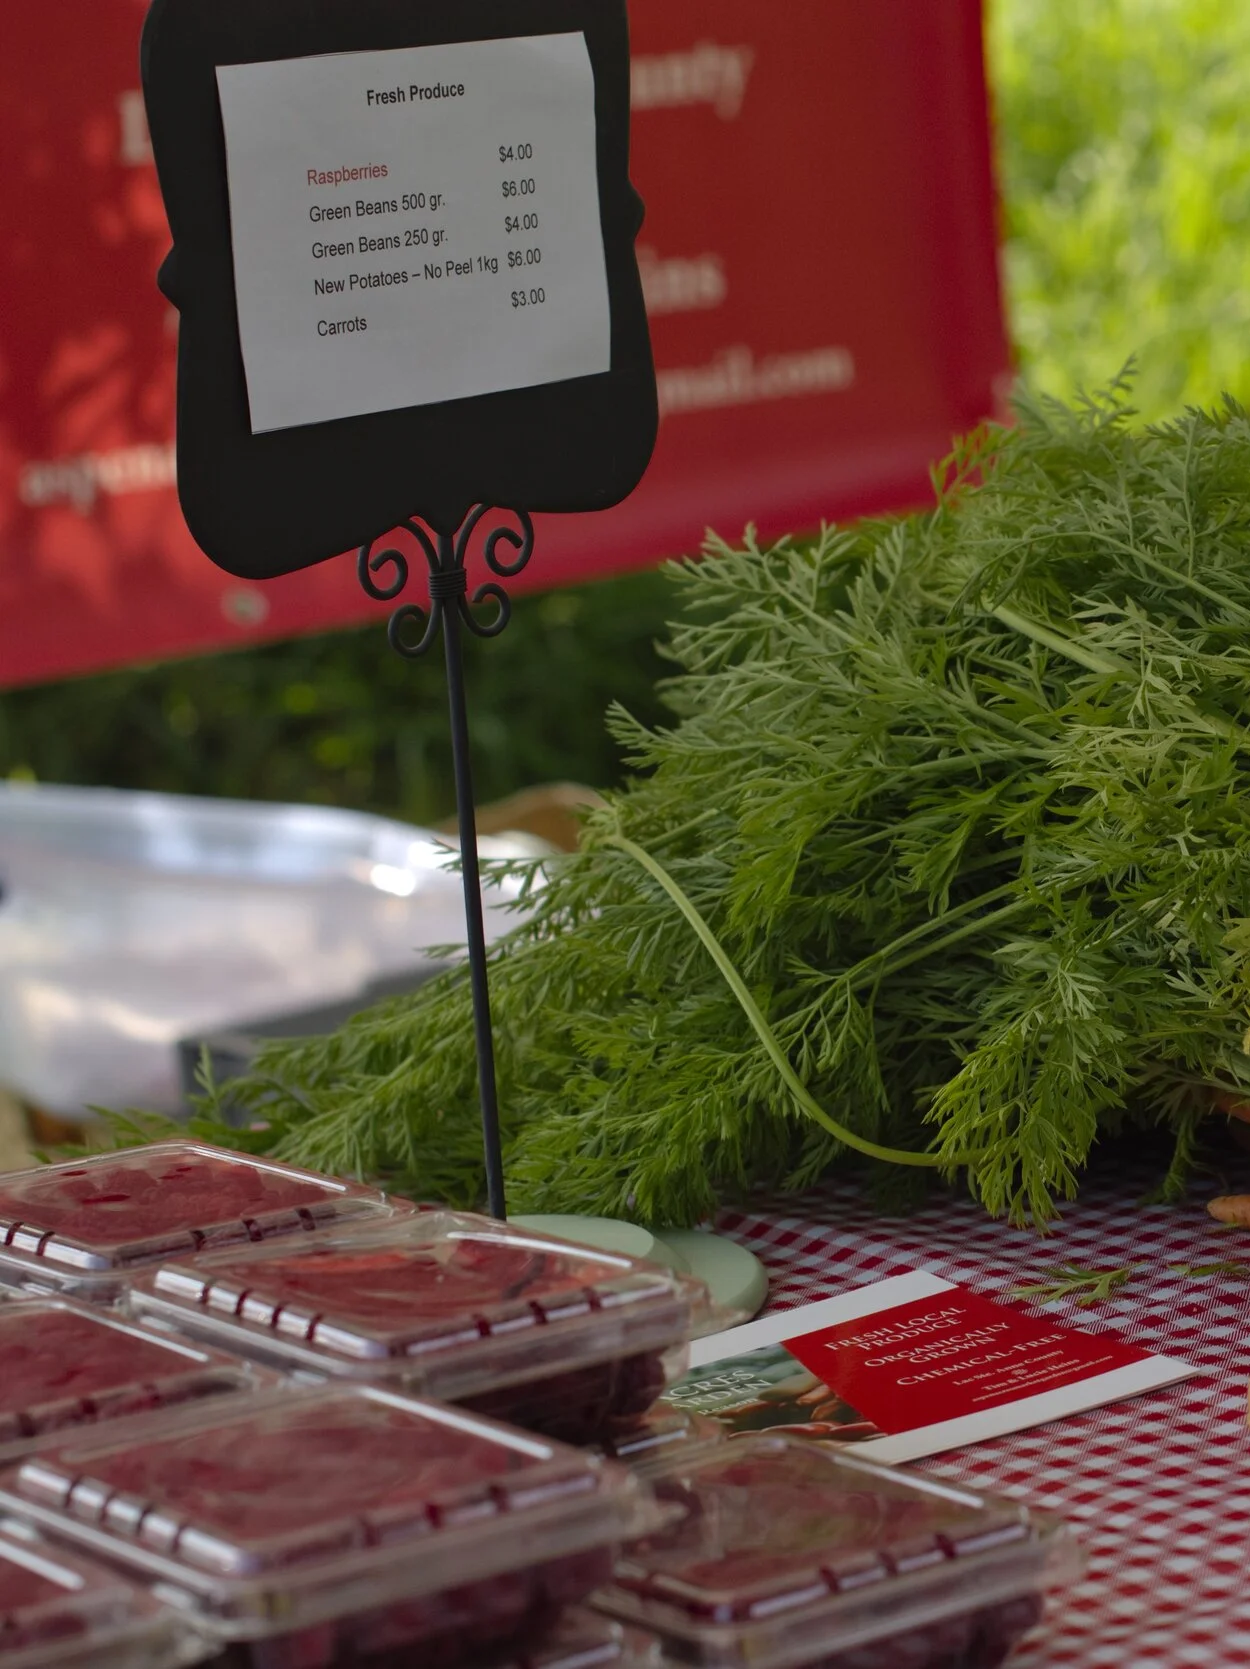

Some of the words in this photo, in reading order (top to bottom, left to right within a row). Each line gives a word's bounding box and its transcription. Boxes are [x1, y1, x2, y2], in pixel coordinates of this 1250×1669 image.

[367, 87, 405, 106] Fresh
[410, 82, 465, 101] Produce
[307, 163, 388, 187] Raspberries
[499, 143, 532, 163] $4.00
[309, 204, 351, 223] Green
[356, 197, 397, 217] Beans
[402, 193, 425, 211] 500
[429, 193, 446, 212] gr.
[502, 178, 536, 198] $6.00
[312, 241, 354, 259] Green
[359, 234, 400, 253] Beans
[404, 229, 428, 247] 250
[432, 229, 448, 248] gr.
[504, 213, 538, 233] $4.00
[314, 277, 345, 295] New
[349, 269, 408, 290] Potatoes
[425, 263, 442, 281] No
[446, 258, 473, 276] Peel
[477, 256, 498, 274] 1kg
[508, 248, 541, 268] $6.00
[317, 317, 367, 336] Carrots
[511, 288, 545, 308] $3.00
[824, 1328, 895, 1351] FRESH
[895, 1307, 967, 1330] LOCAL
[857, 1317, 962, 1351] PRODUCE
[864, 1322, 1011, 1368] ORGANICALLY
[909, 1336, 997, 1364] GROWN
[896, 1333, 1068, 1386] CHEMICAL-FREE
